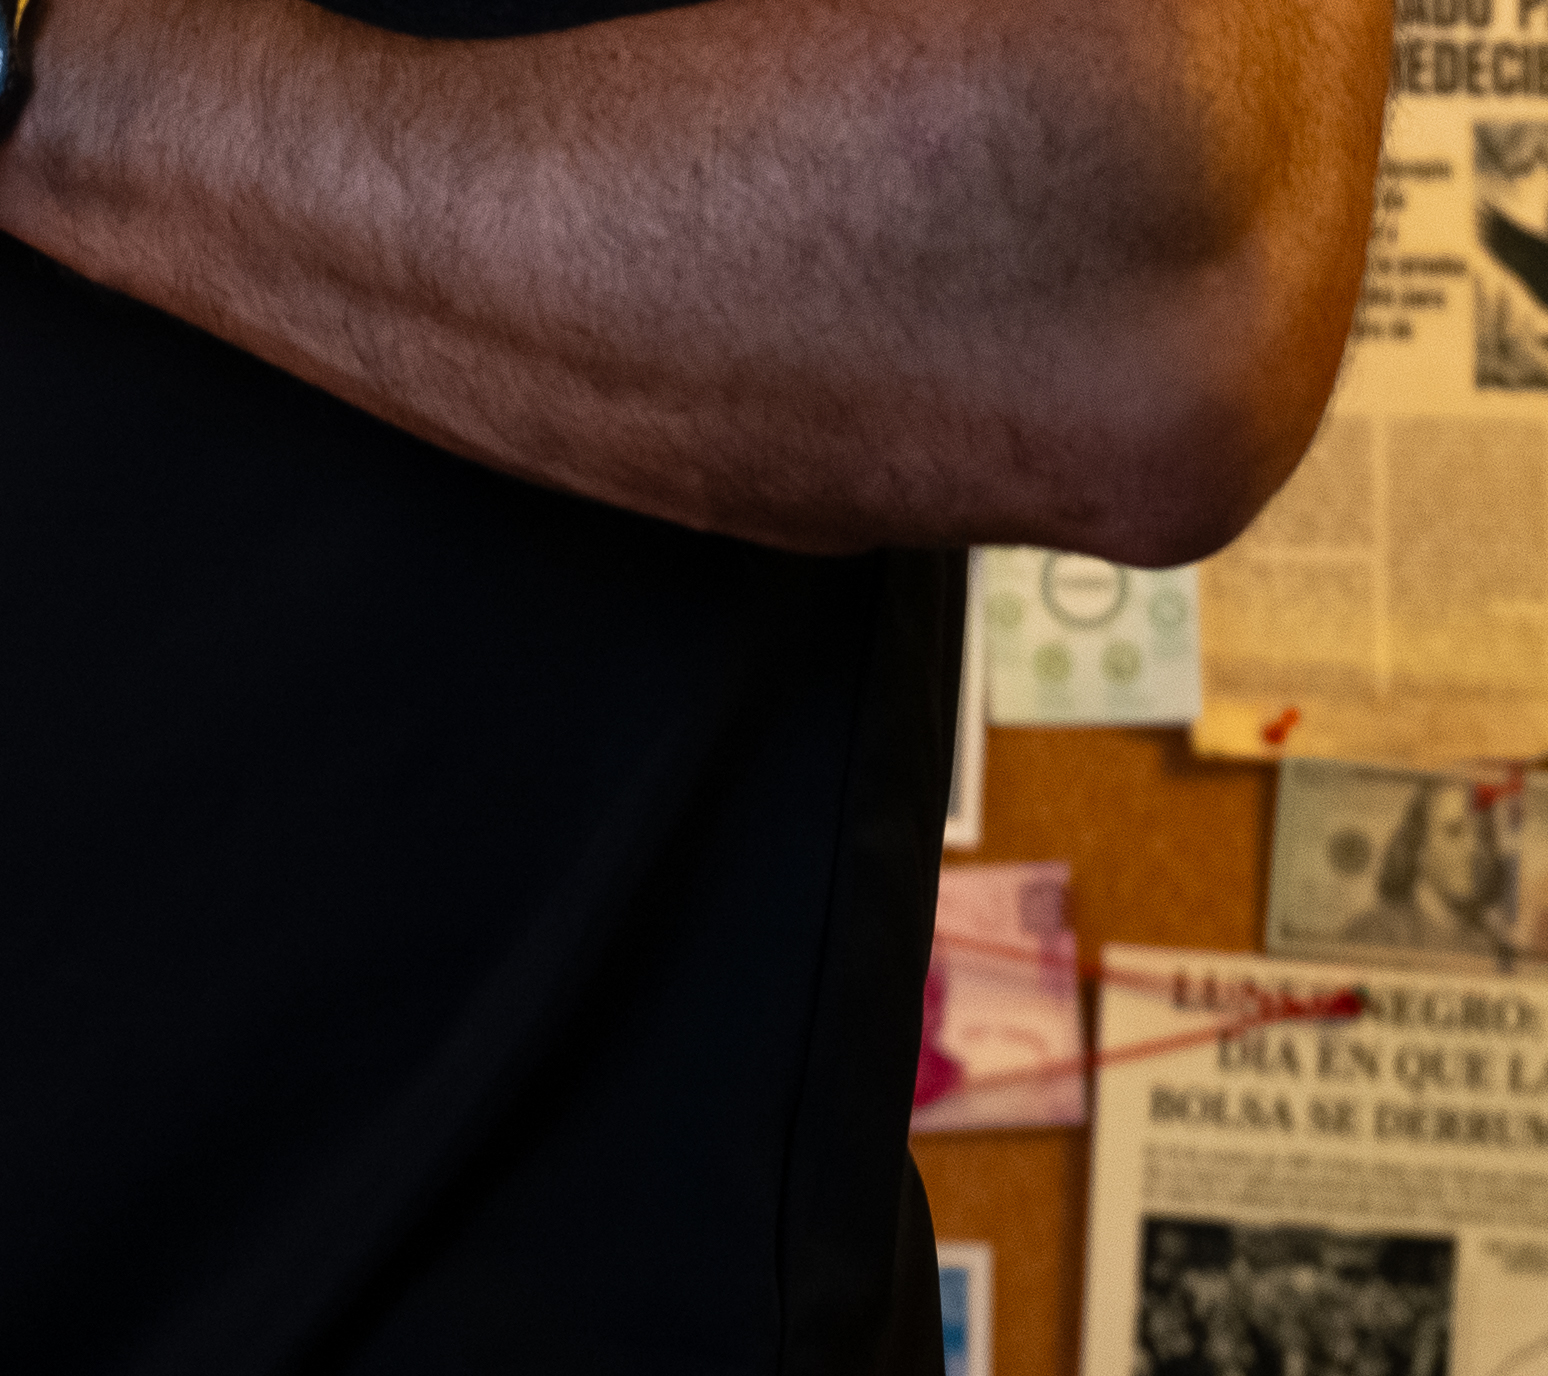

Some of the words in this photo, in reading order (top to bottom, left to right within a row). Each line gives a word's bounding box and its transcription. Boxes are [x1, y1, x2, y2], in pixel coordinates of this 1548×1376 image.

[1316, 1036, 1384, 1082] EN
[1394, 1041, 1490, 1095] QUE
[1146, 1084, 1295, 1131] BOLSA
[1306, 1094, 1358, 1137] SE
